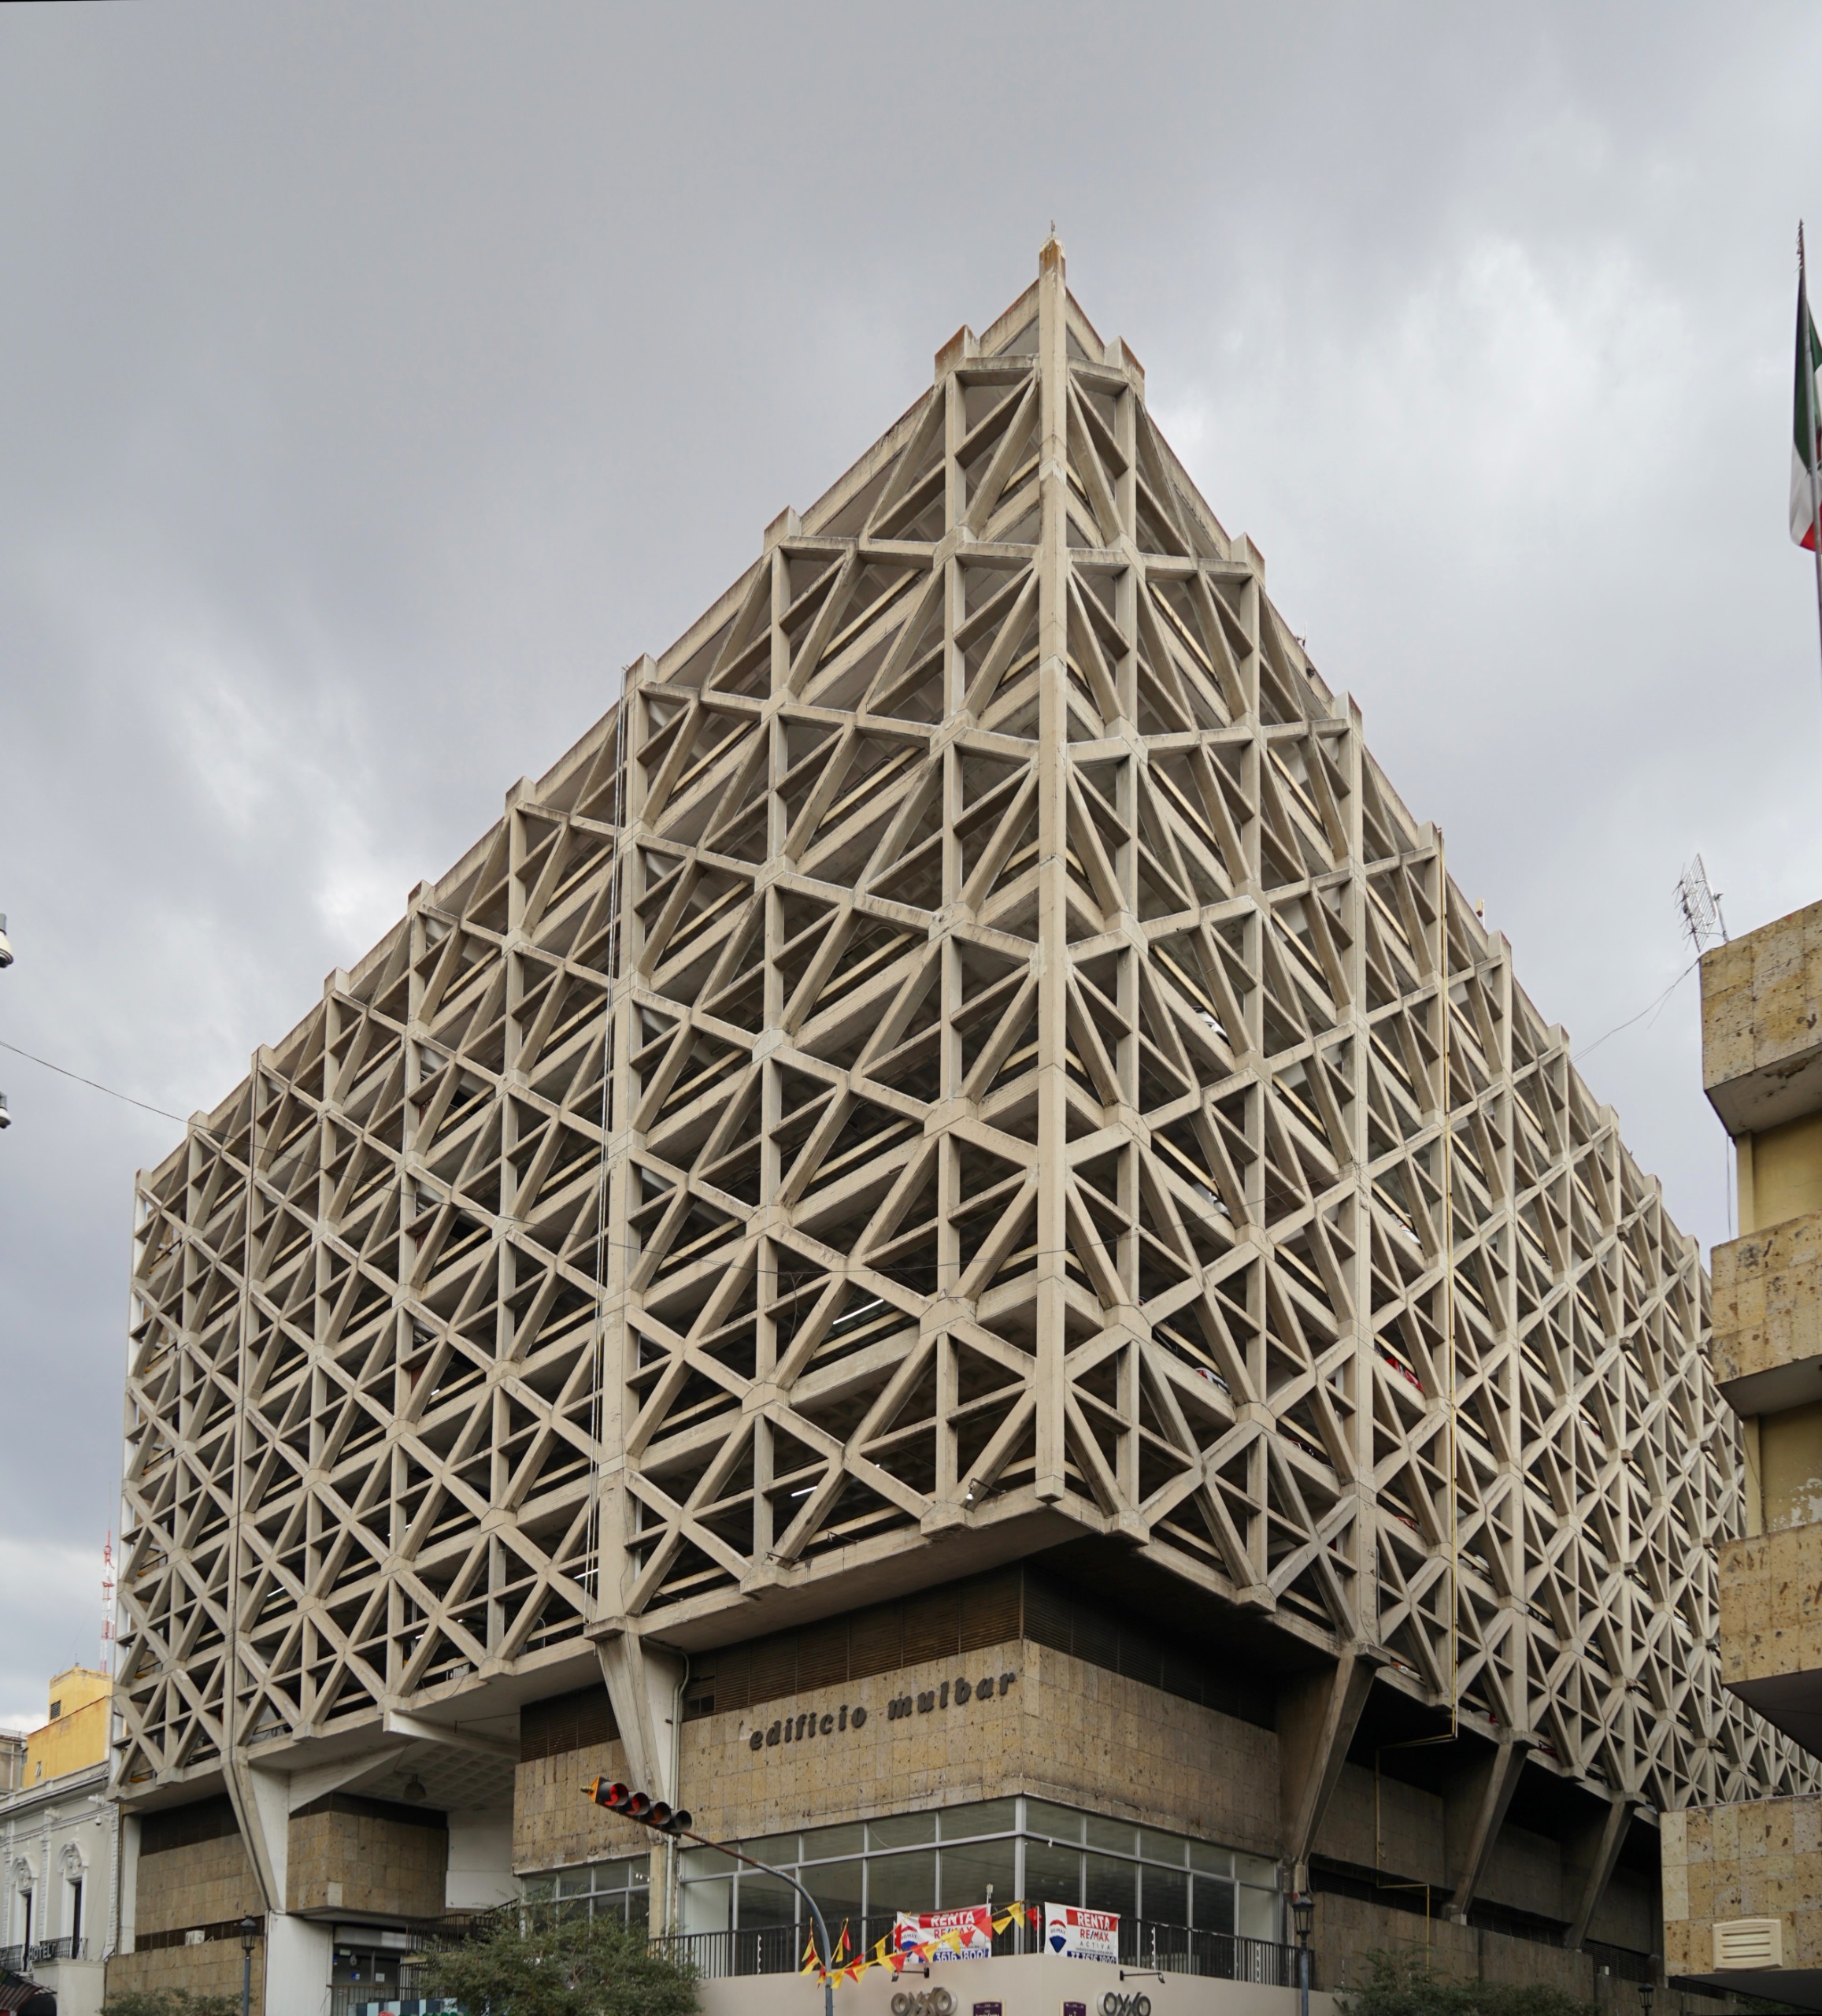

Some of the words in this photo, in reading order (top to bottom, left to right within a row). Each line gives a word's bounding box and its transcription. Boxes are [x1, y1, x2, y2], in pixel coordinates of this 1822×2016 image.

[750, 1704, 867, 1750] edificio
[887, 1672, 1016, 1720] mulbar
[931, 1910, 975, 1927] RENTA
[1077, 1911, 1110, 1930] RENTA
[934, 1926, 972, 1939] RE/AX
[1080, 1928, 1109, 1942] RE/MAX
[28, 1944, 51, 1960] HOTEL
[1080, 1940, 1110, 1950] ACTIVA
[936, 1951, 957, 1962] 3616
[891, 1987, 957, 2016] OXXO
[1098, 1992, 1151, 2016] OXXO
